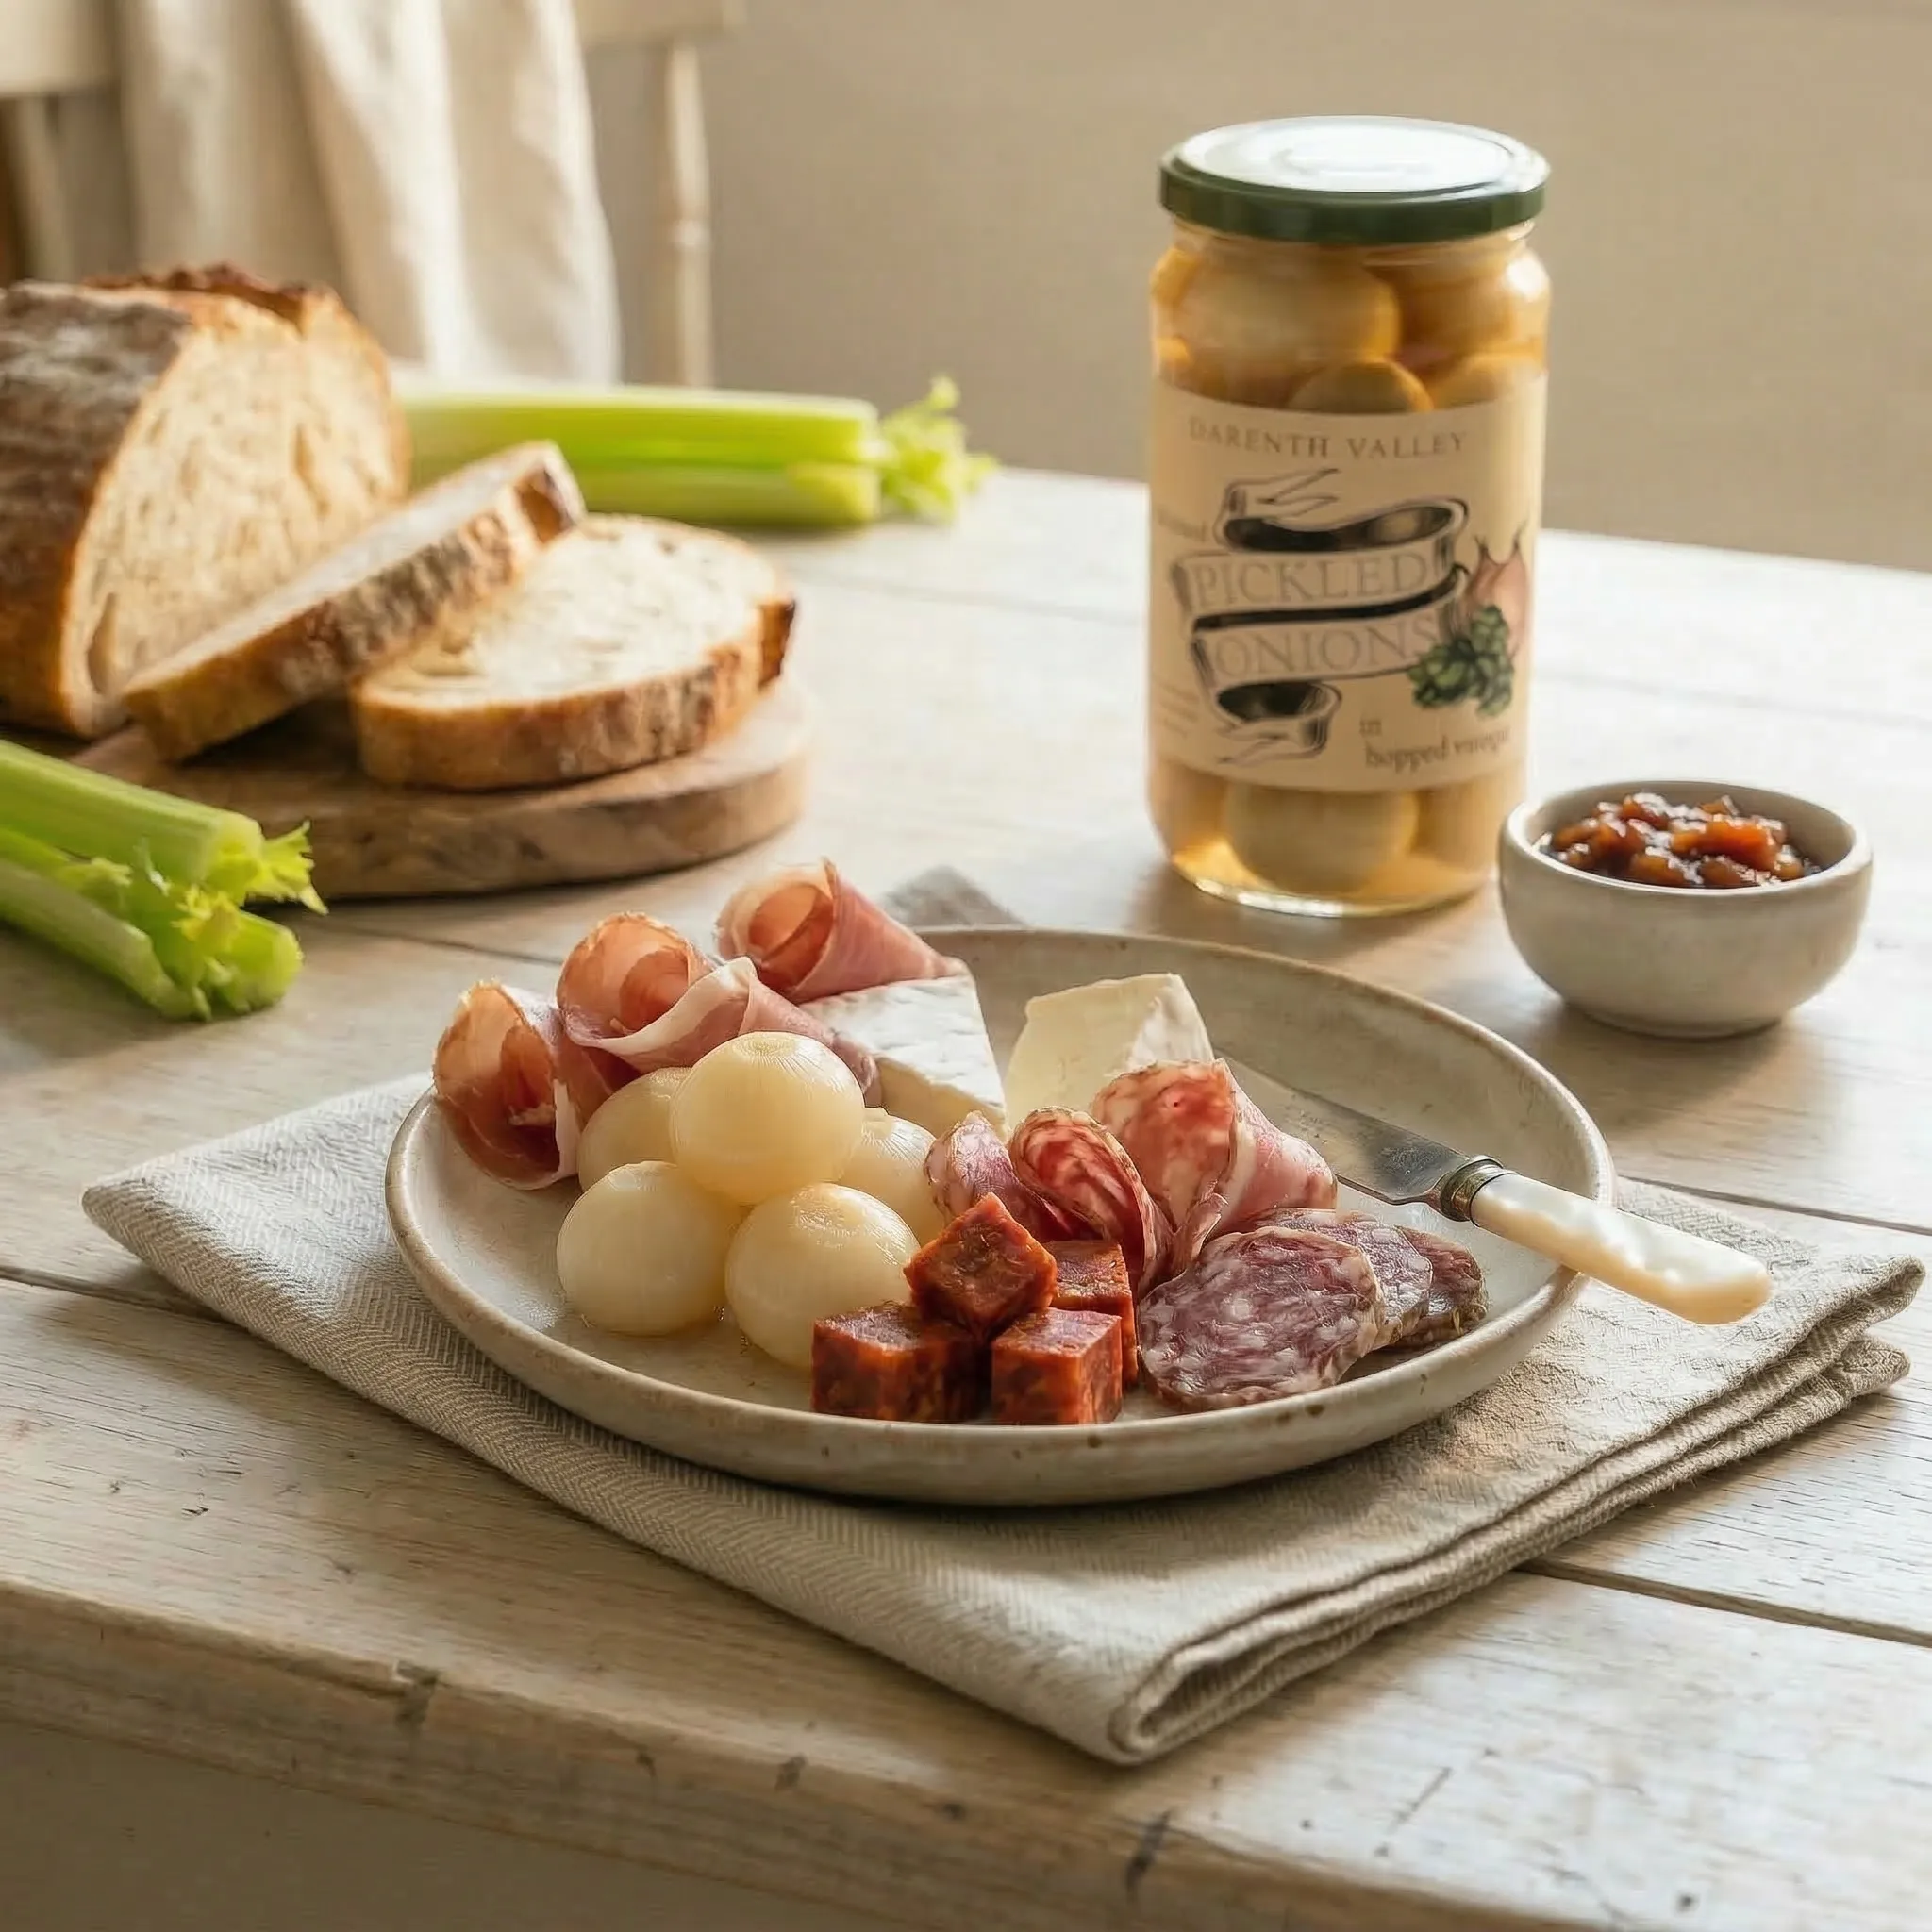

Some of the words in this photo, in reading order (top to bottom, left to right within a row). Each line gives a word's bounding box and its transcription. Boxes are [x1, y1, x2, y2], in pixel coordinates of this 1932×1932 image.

[1188, 414, 1330, 459] DARENTH
[1346, 430, 1467, 459] VALLEY
[1194, 552, 1427, 608] PICKLED
[1215, 612, 1441, 678] ONIONS
